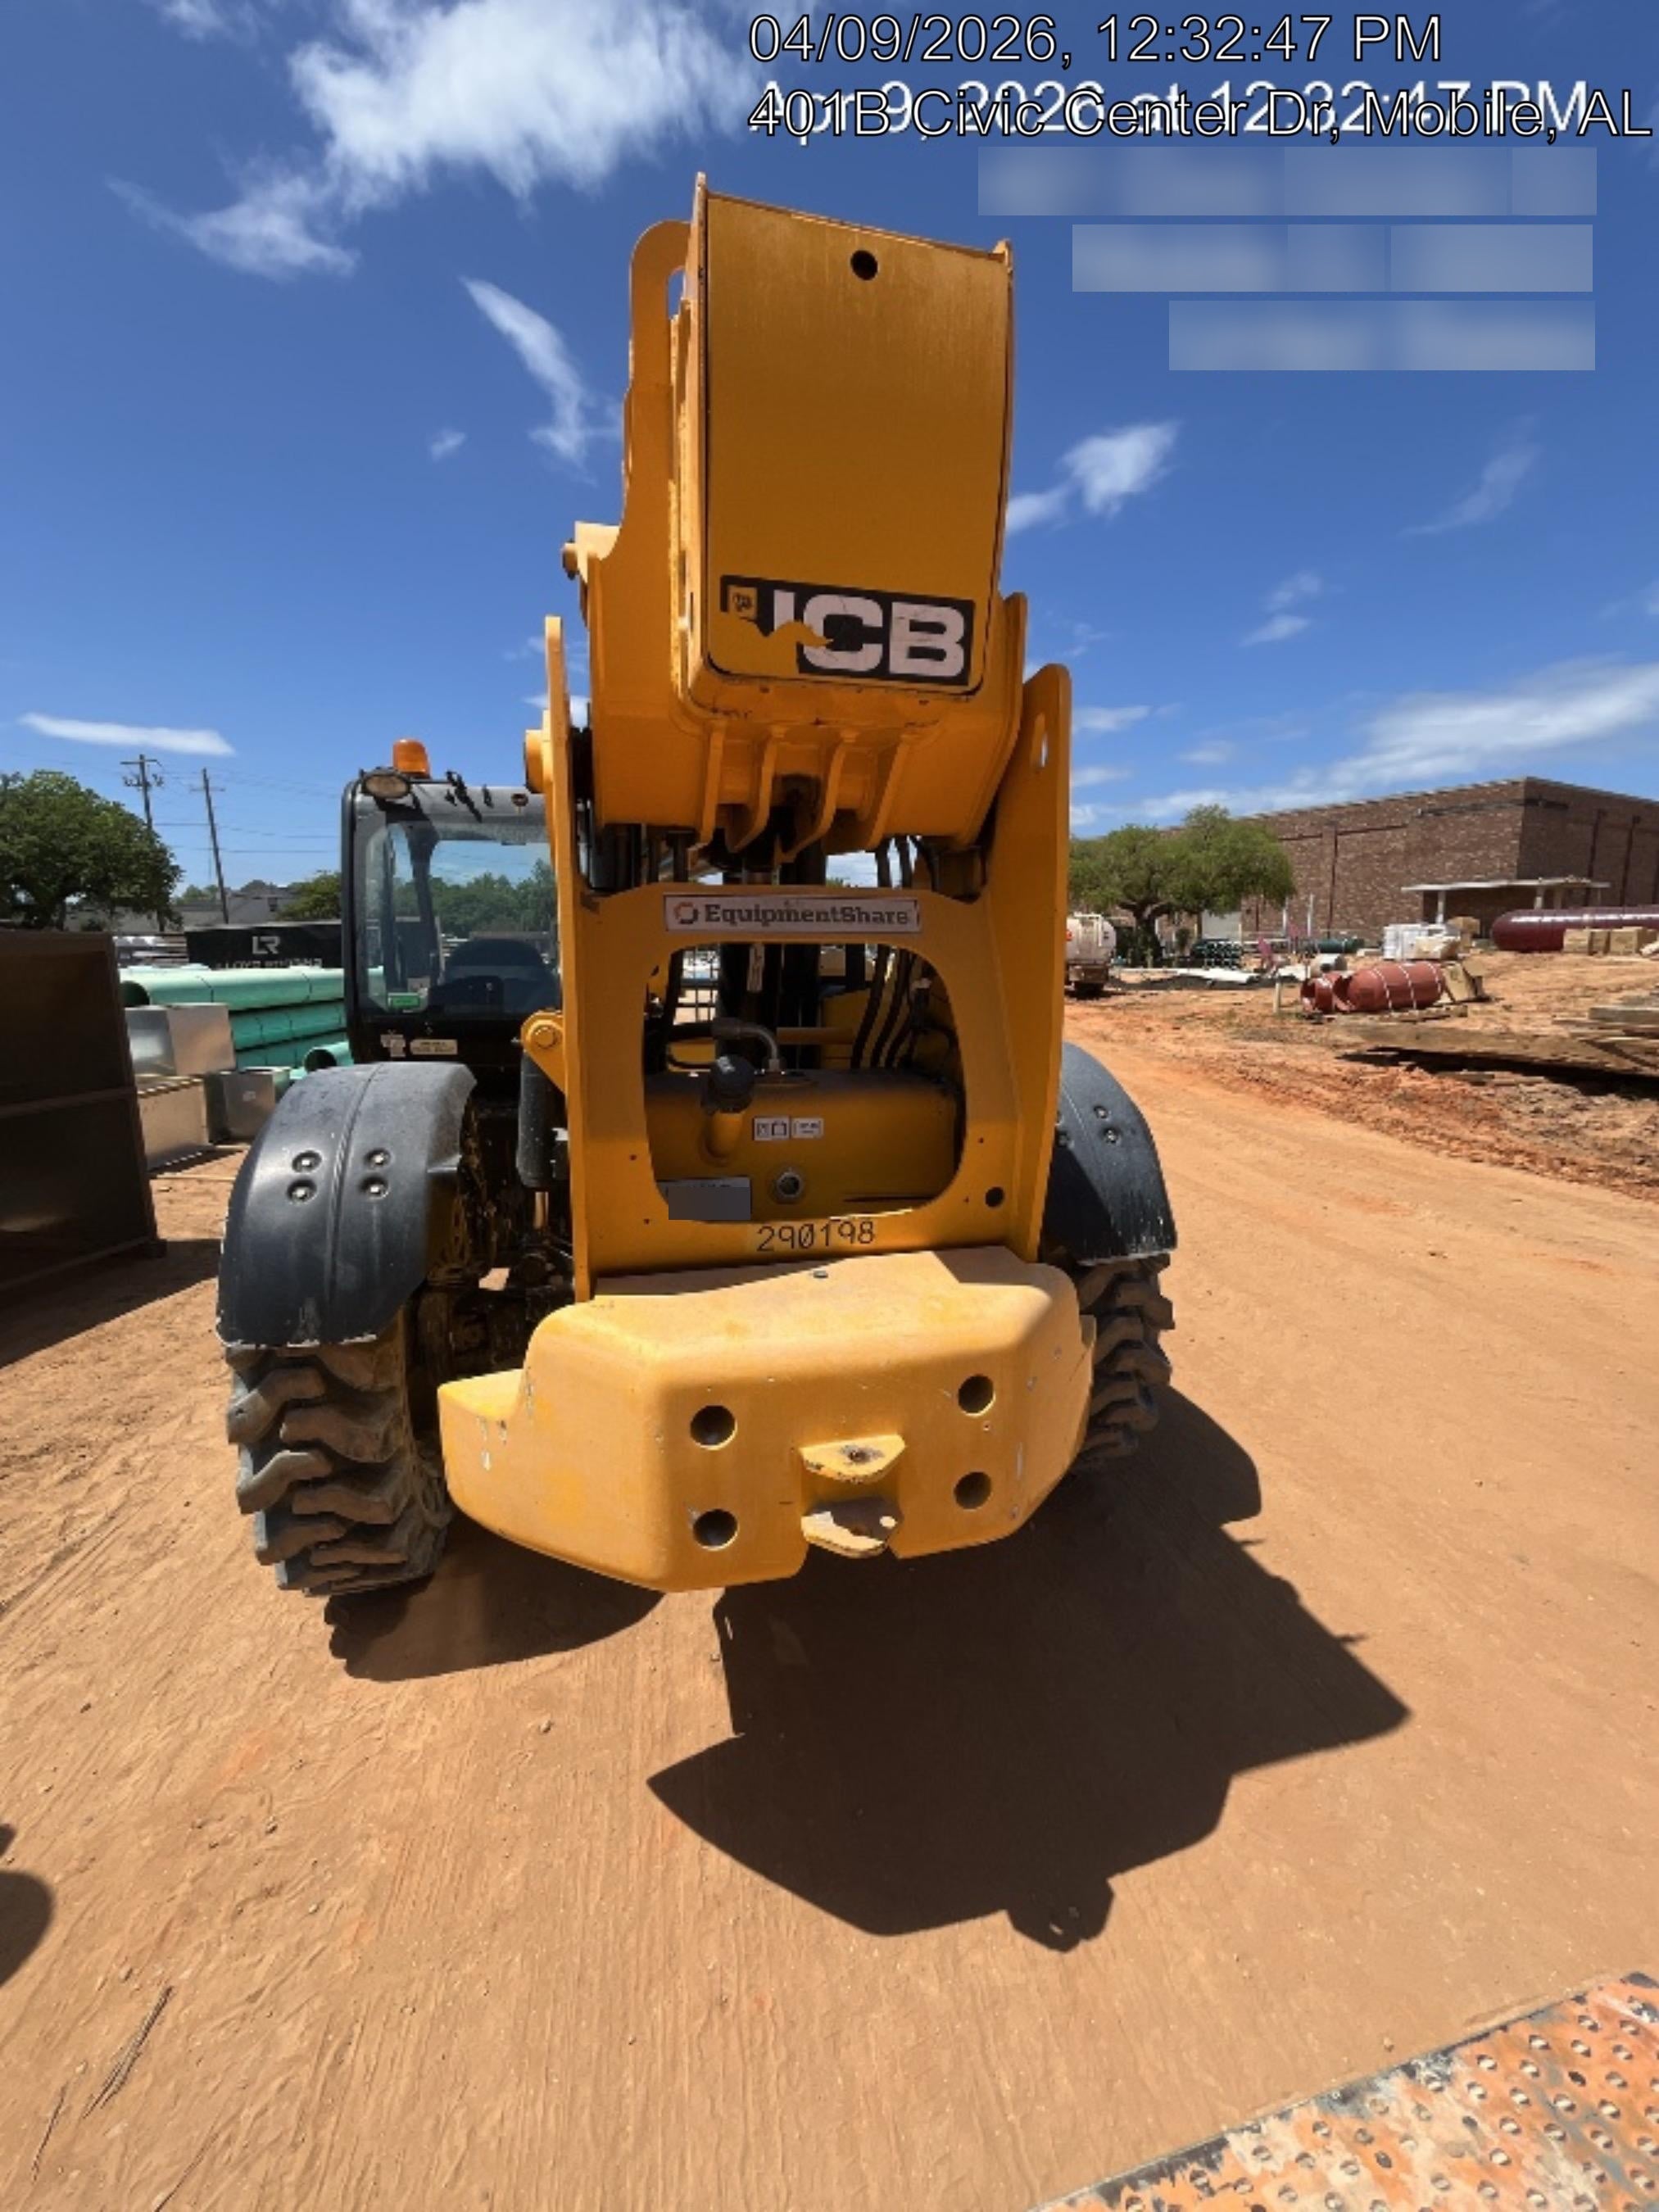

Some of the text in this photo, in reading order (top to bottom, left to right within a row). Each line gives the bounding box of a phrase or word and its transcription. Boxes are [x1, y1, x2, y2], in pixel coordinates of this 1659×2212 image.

[705, 904, 909, 927] EquipmentShare
[252, 936, 280, 954] LR
[756, 1220, 875, 1252] 290198
